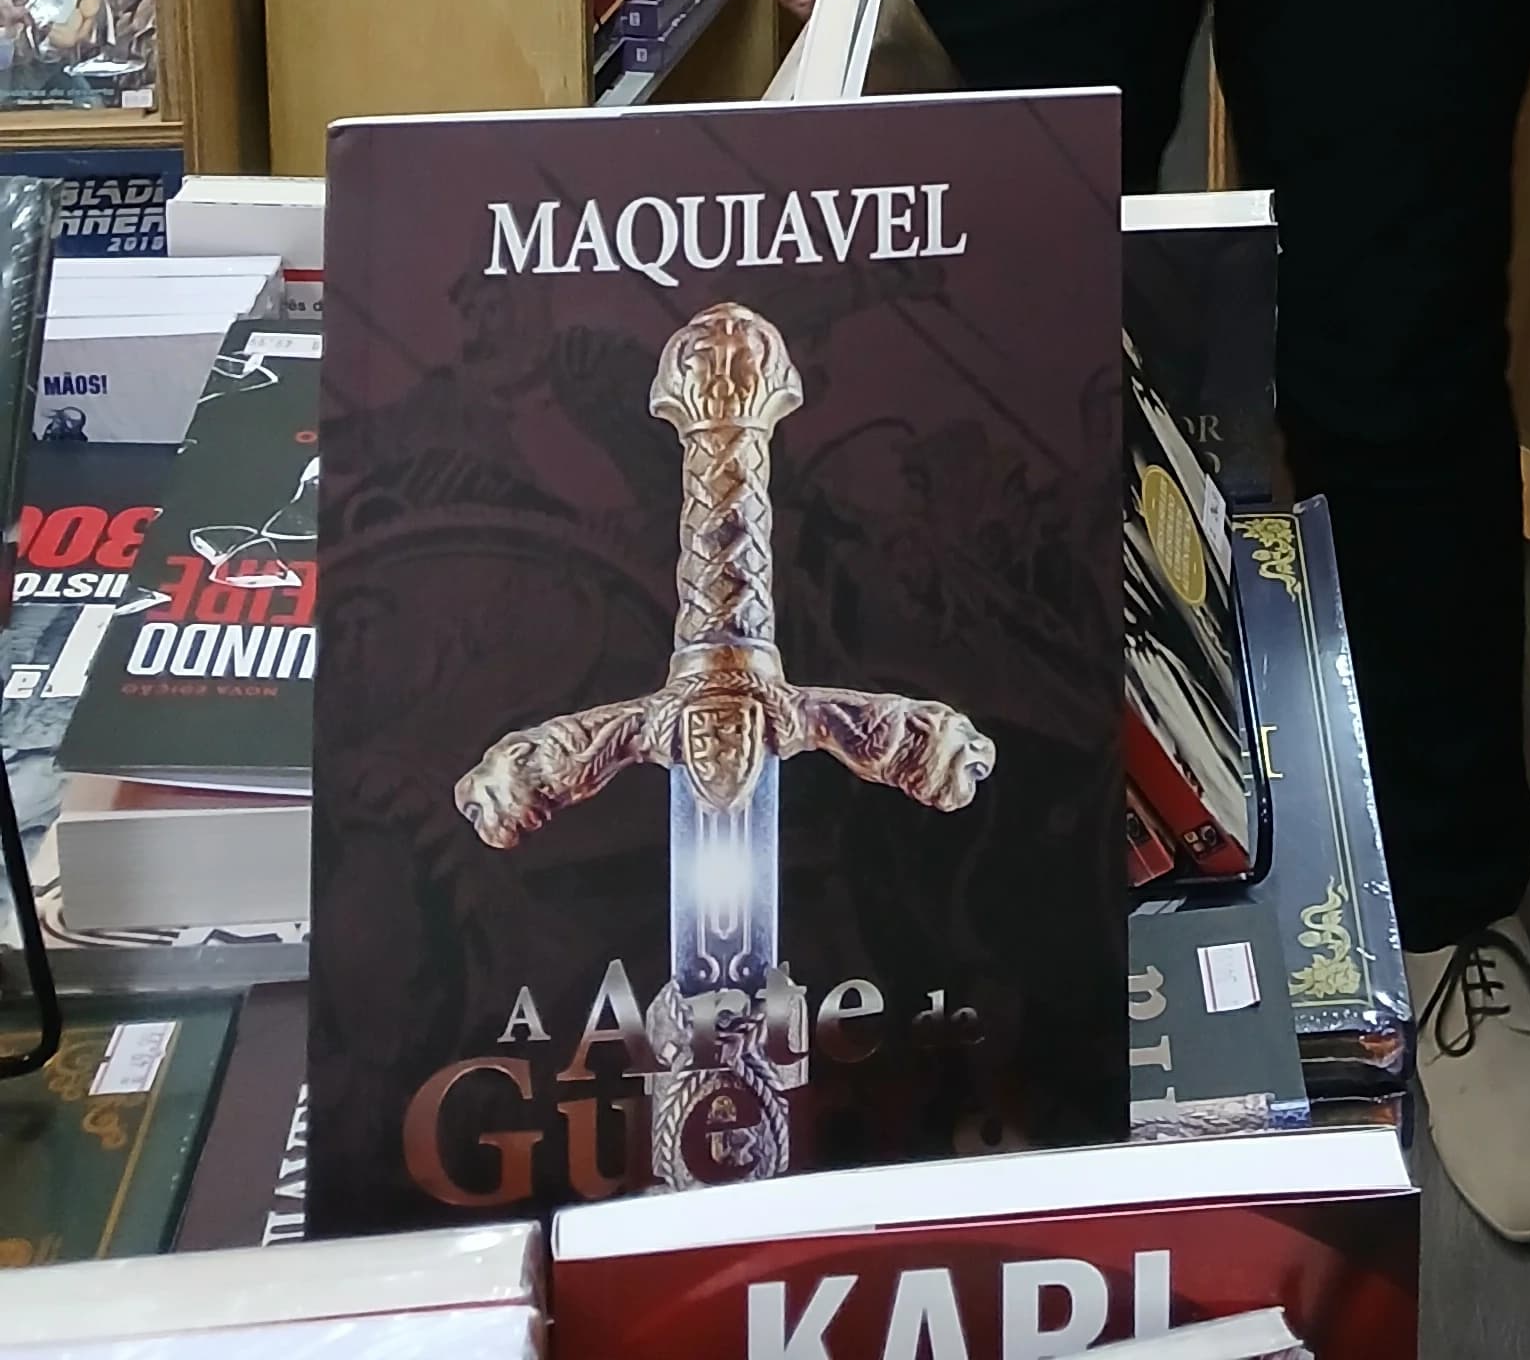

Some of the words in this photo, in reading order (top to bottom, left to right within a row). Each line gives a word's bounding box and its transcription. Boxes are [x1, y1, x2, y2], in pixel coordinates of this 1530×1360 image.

[483, 182, 968, 287] MAQUIAVEL
[43, 373, 108, 398] MÃOS!
[496, 985, 552, 1044] A
[555, 958, 886, 1087] Arte
[911, 988, 986, 1046] de
[401, 1055, 1030, 1208] Gue
